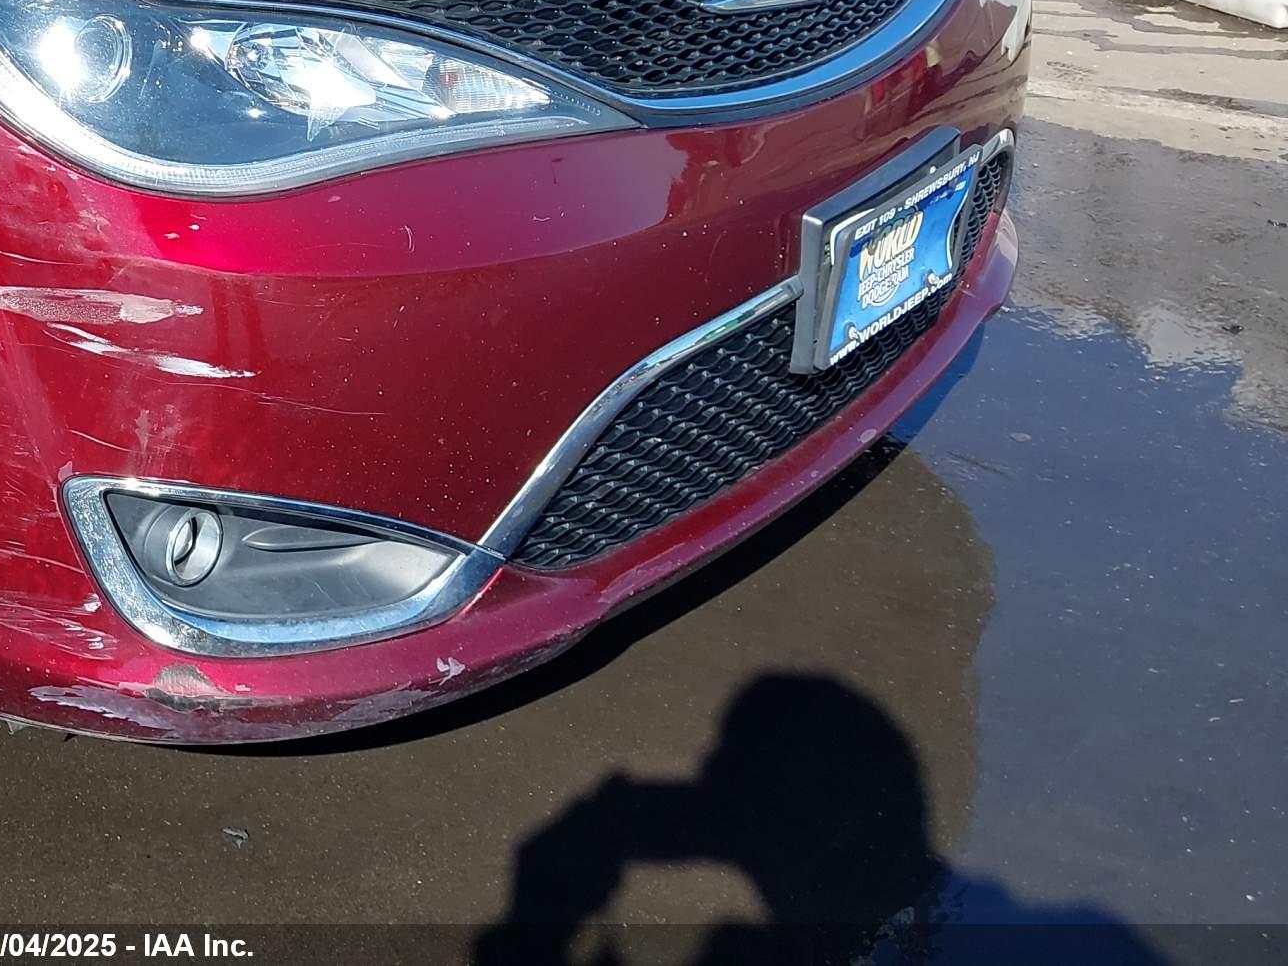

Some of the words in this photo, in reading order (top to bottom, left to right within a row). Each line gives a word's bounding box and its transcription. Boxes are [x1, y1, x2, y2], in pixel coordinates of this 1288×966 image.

[855, 218, 878, 240] EXIT
[879, 208, 895, 225] 109
[968, 151, 981, 167] NJ
